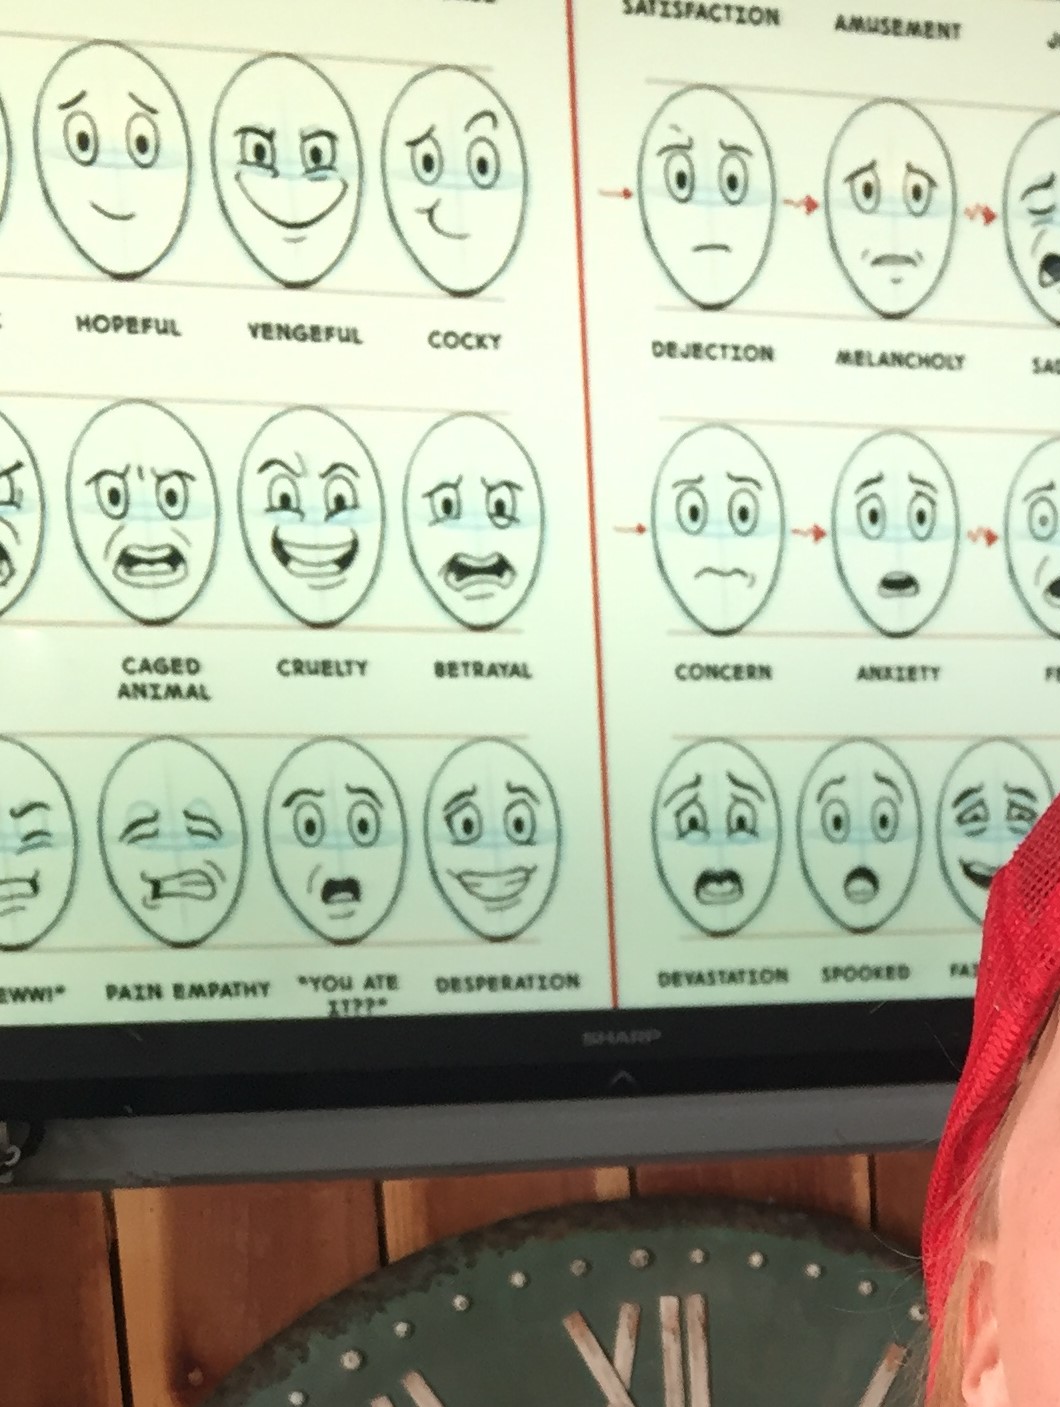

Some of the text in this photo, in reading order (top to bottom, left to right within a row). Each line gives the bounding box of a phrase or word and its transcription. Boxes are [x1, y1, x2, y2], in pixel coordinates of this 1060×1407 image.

[621, 0, 782, 27] SATISFACTION
[834, 13, 963, 41] AMUSEMENT
[75, 313, 182, 338] HOPEFUL
[247, 321, 364, 346] VENGEFUL
[427, 329, 503, 351] COCKY
[651, 340, 775, 363] DEJECTION
[835, 349, 966, 371] MELANCHOLY
[121, 656, 203, 677] CAGED
[275, 657, 369, 678] CRUELTY
[433, 660, 534, 680] BETRAYAL
[674, 662, 773, 682] CONCERN
[856, 664, 941, 683] ANXIETY
[117, 682, 213, 702] ANIMAL
[297, 973, 400, 994] "YOU ATE
[434, 972, 582, 994] DESPERATION
[657, 967, 790, 989] DEVASTATION
[821, 963, 912, 984] SPOOKED
[104, 980, 272, 1002] PAIN EMPATHY
